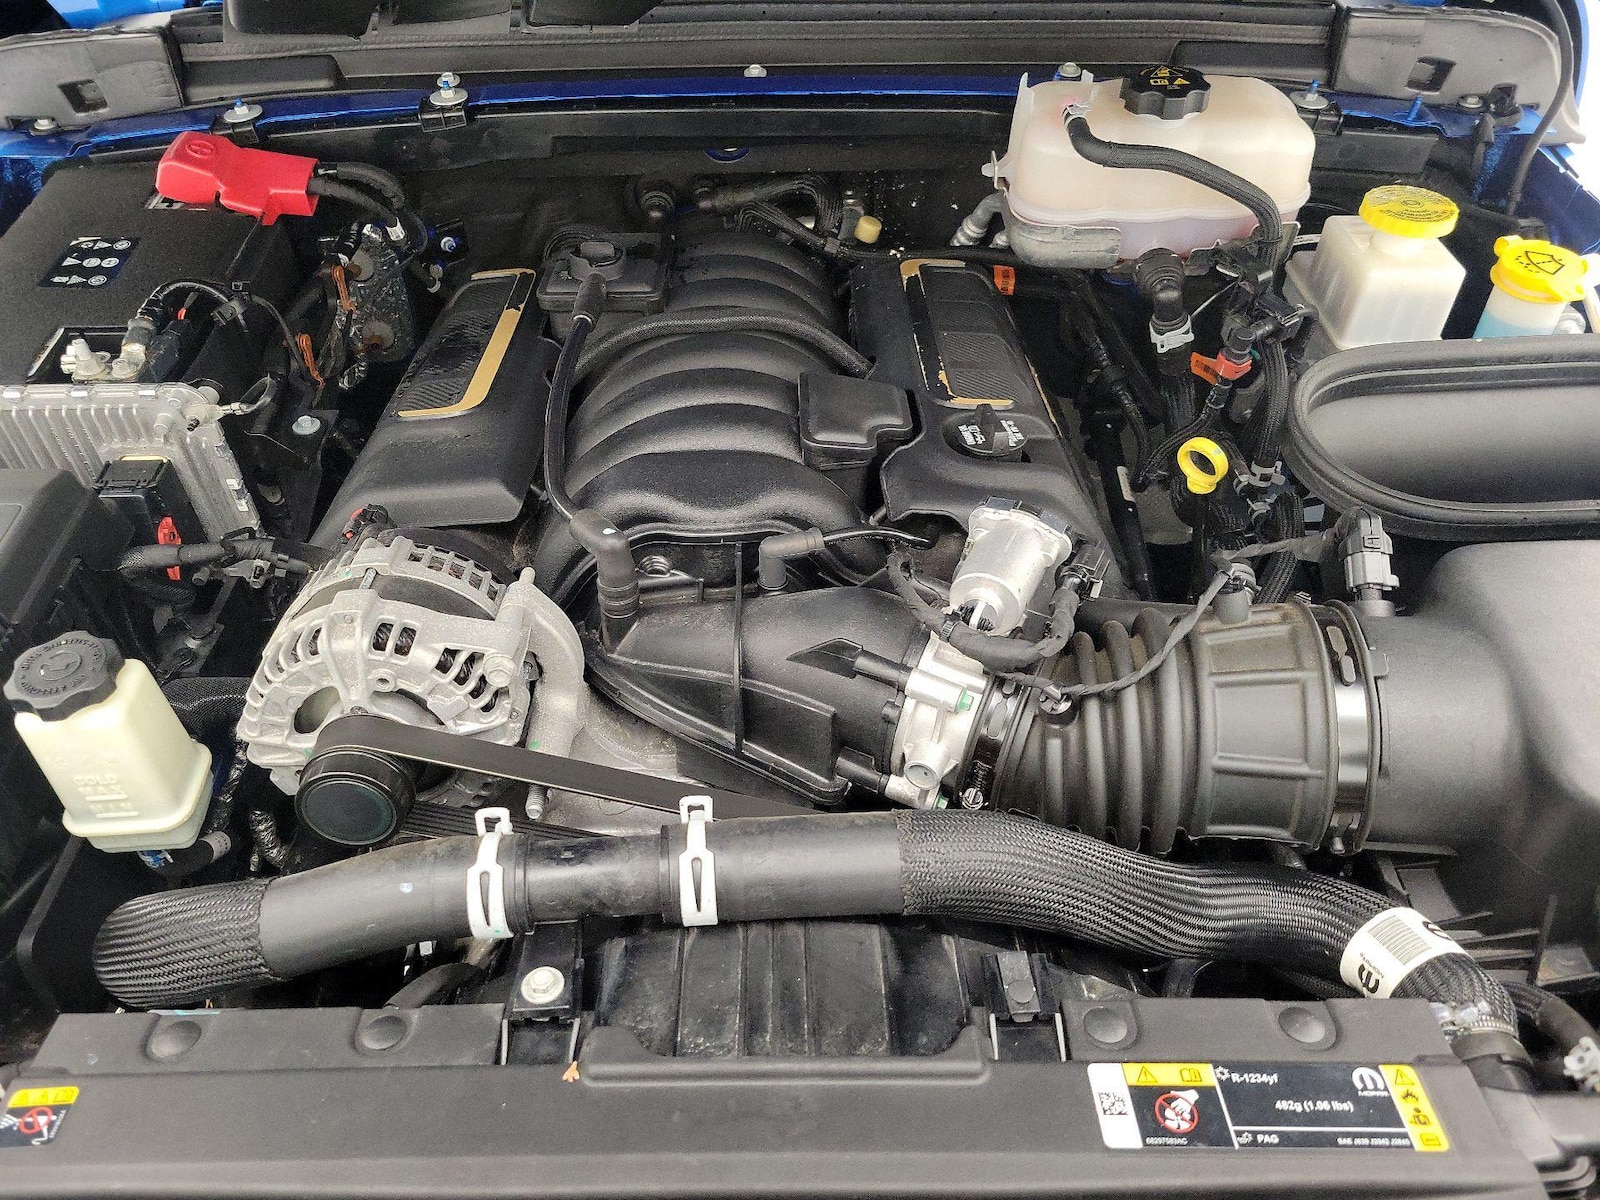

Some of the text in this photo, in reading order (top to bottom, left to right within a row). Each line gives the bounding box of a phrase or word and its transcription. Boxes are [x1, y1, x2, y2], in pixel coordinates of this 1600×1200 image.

[1231, 1073, 1278, 1085] R-1234yf
[1275, 1100, 1303, 1113] 482g
[1256, 1133, 1280, 1144] PAG
